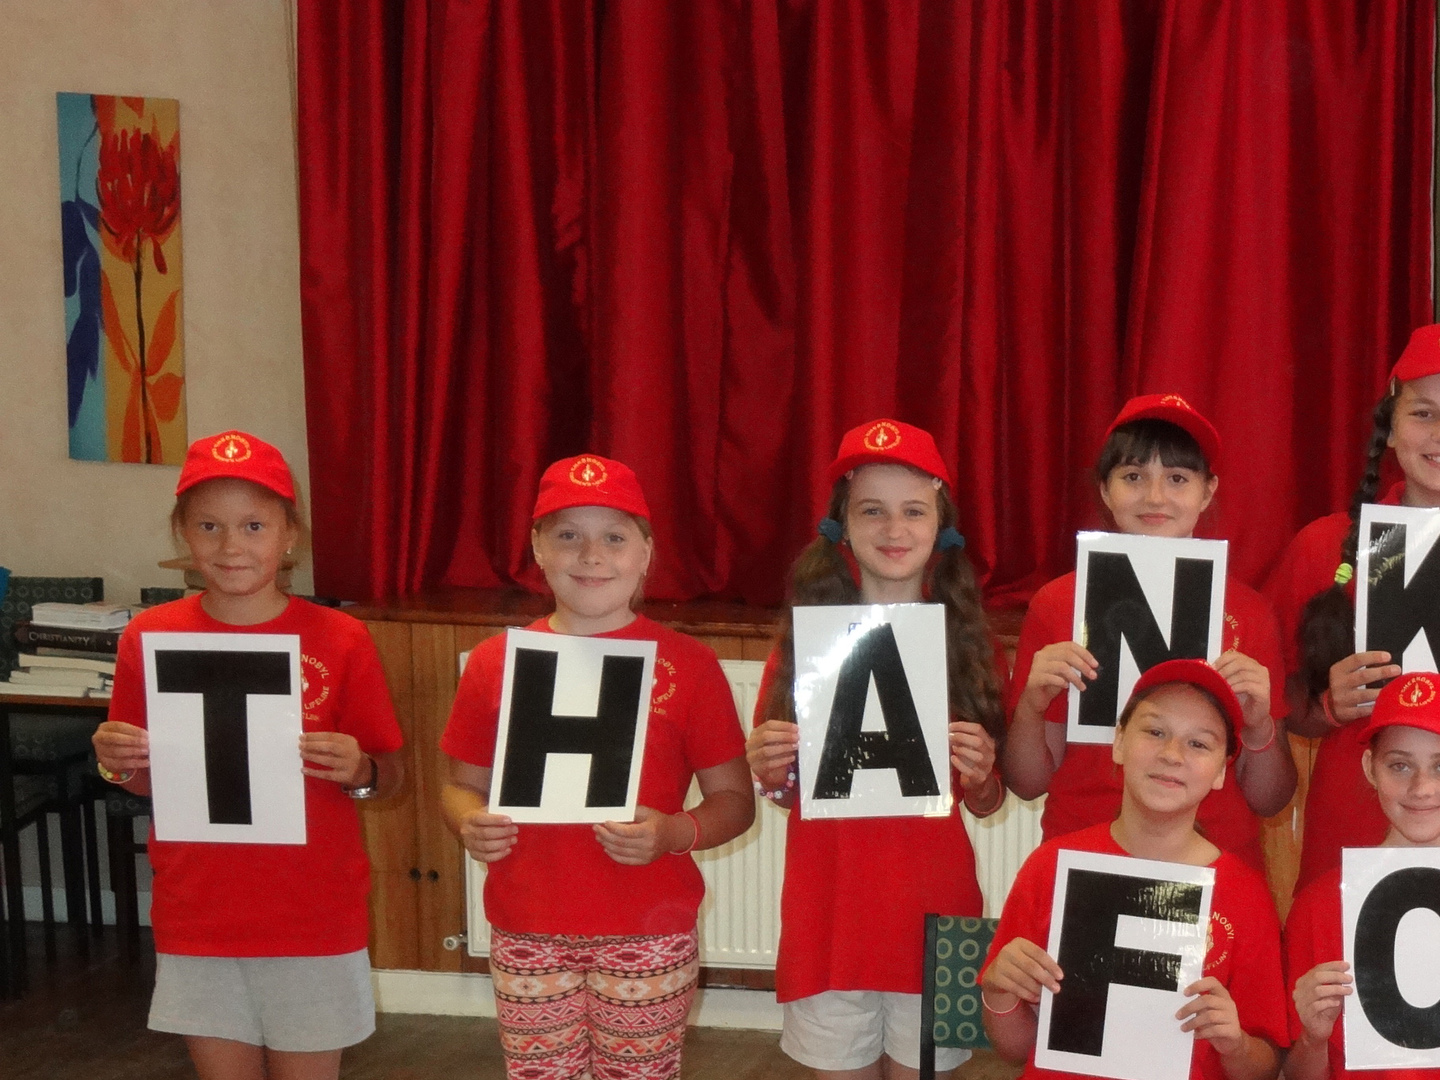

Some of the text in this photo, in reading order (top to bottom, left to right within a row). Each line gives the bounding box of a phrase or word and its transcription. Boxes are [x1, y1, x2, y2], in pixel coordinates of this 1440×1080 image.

[301, 653, 330, 679] NOBYL
[812, 622, 941, 800] A
[1078, 551, 1214, 727] N
[155, 649, 292, 826] T
[499, 648, 645, 809] H
[1048, 868, 1203, 1057] F
